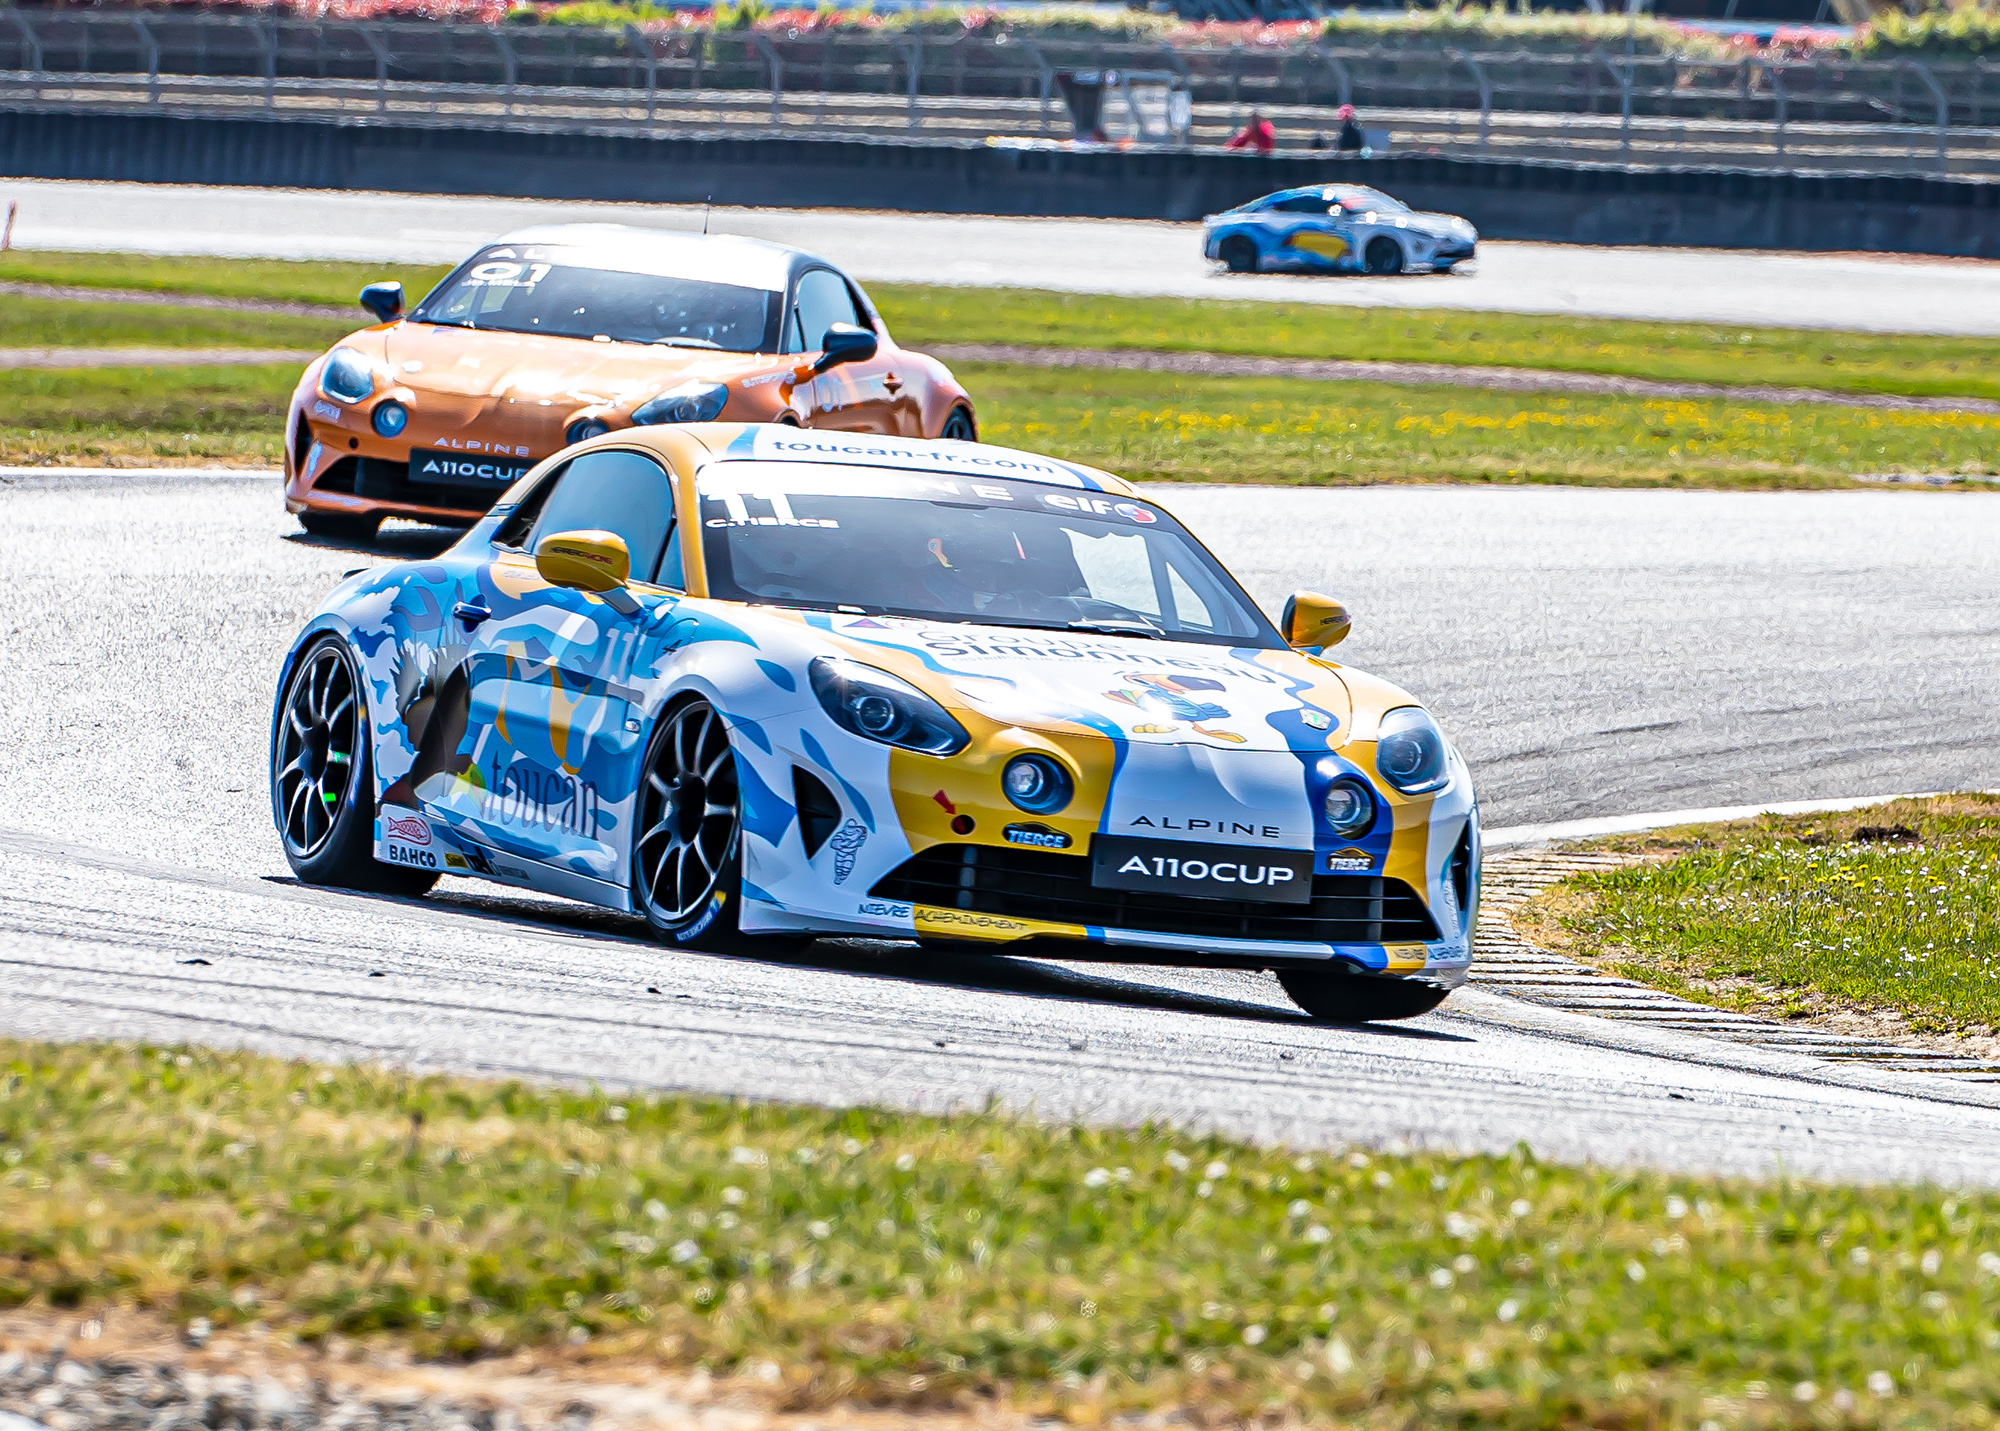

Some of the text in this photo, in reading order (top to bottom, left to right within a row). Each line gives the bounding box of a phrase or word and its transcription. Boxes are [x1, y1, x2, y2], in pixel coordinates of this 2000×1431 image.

[470, 261, 552, 283] 01
[434, 437, 530, 457] ALPINE
[773, 440, 1057, 474] toucan-fr.com
[707, 494, 795, 520] 11
[1043, 494, 1113, 515] elf
[706, 516, 840, 529] C.TIERCE
[925, 641, 1277, 684] Simonneau
[488, 750, 599, 841] toucan
[1129, 815, 1281, 838] ALPINE
[1007, 830, 1066, 849] TIERCE
[388, 844, 437, 868] BAHCO
[1117, 856, 1294, 885] A110CUP
